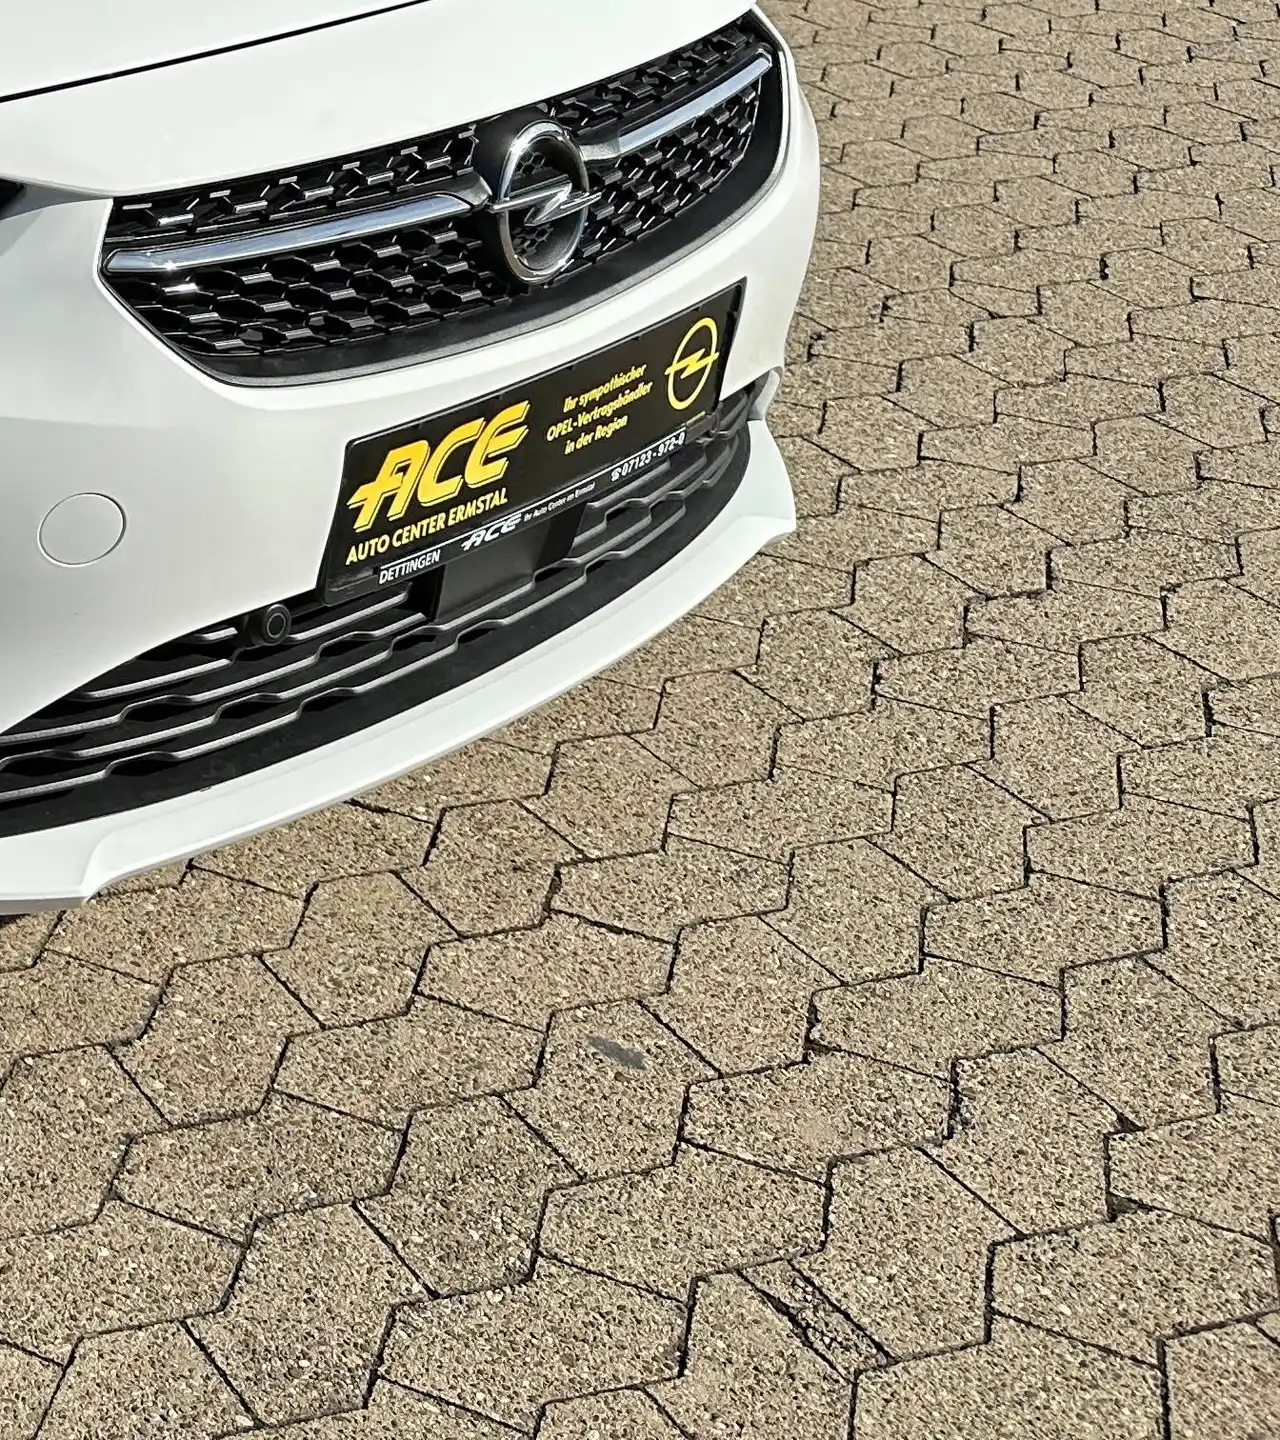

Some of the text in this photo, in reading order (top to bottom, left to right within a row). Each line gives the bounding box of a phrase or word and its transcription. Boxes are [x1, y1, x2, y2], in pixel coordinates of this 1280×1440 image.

[546, 382, 654, 442] OPEL-Vertragshändler
[563, 364, 648, 413] Ihr sympathischer
[347, 400, 531, 533] ACE
[564, 415, 629, 455] in der Region
[345, 487, 509, 566] AUTO CENTER ERMSTAL
[378, 549, 441, 585] DETTINGEN
[461, 512, 522, 551] ACE
